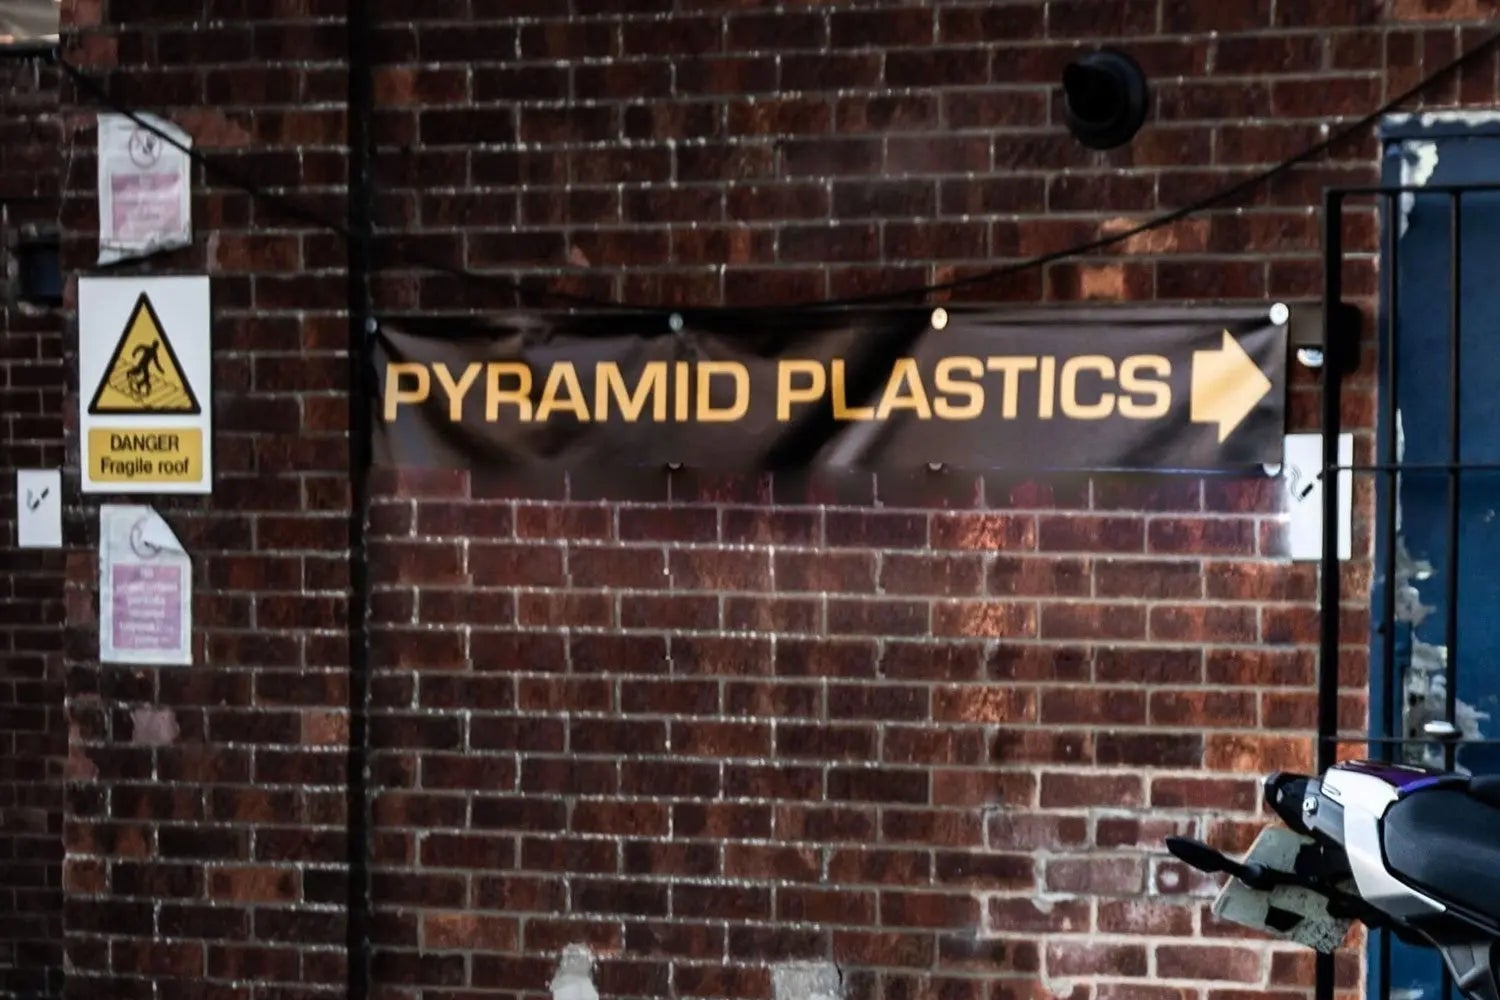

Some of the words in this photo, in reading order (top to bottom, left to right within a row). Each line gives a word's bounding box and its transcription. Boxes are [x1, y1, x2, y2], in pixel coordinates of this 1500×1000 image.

[384, 360, 750, 422] PYRAMID
[776, 354, 1172, 421] PLASTICS
[110, 433, 180, 452] DANGER
[101, 456, 153, 477] Fragile
[158, 456, 189, 475] roof
